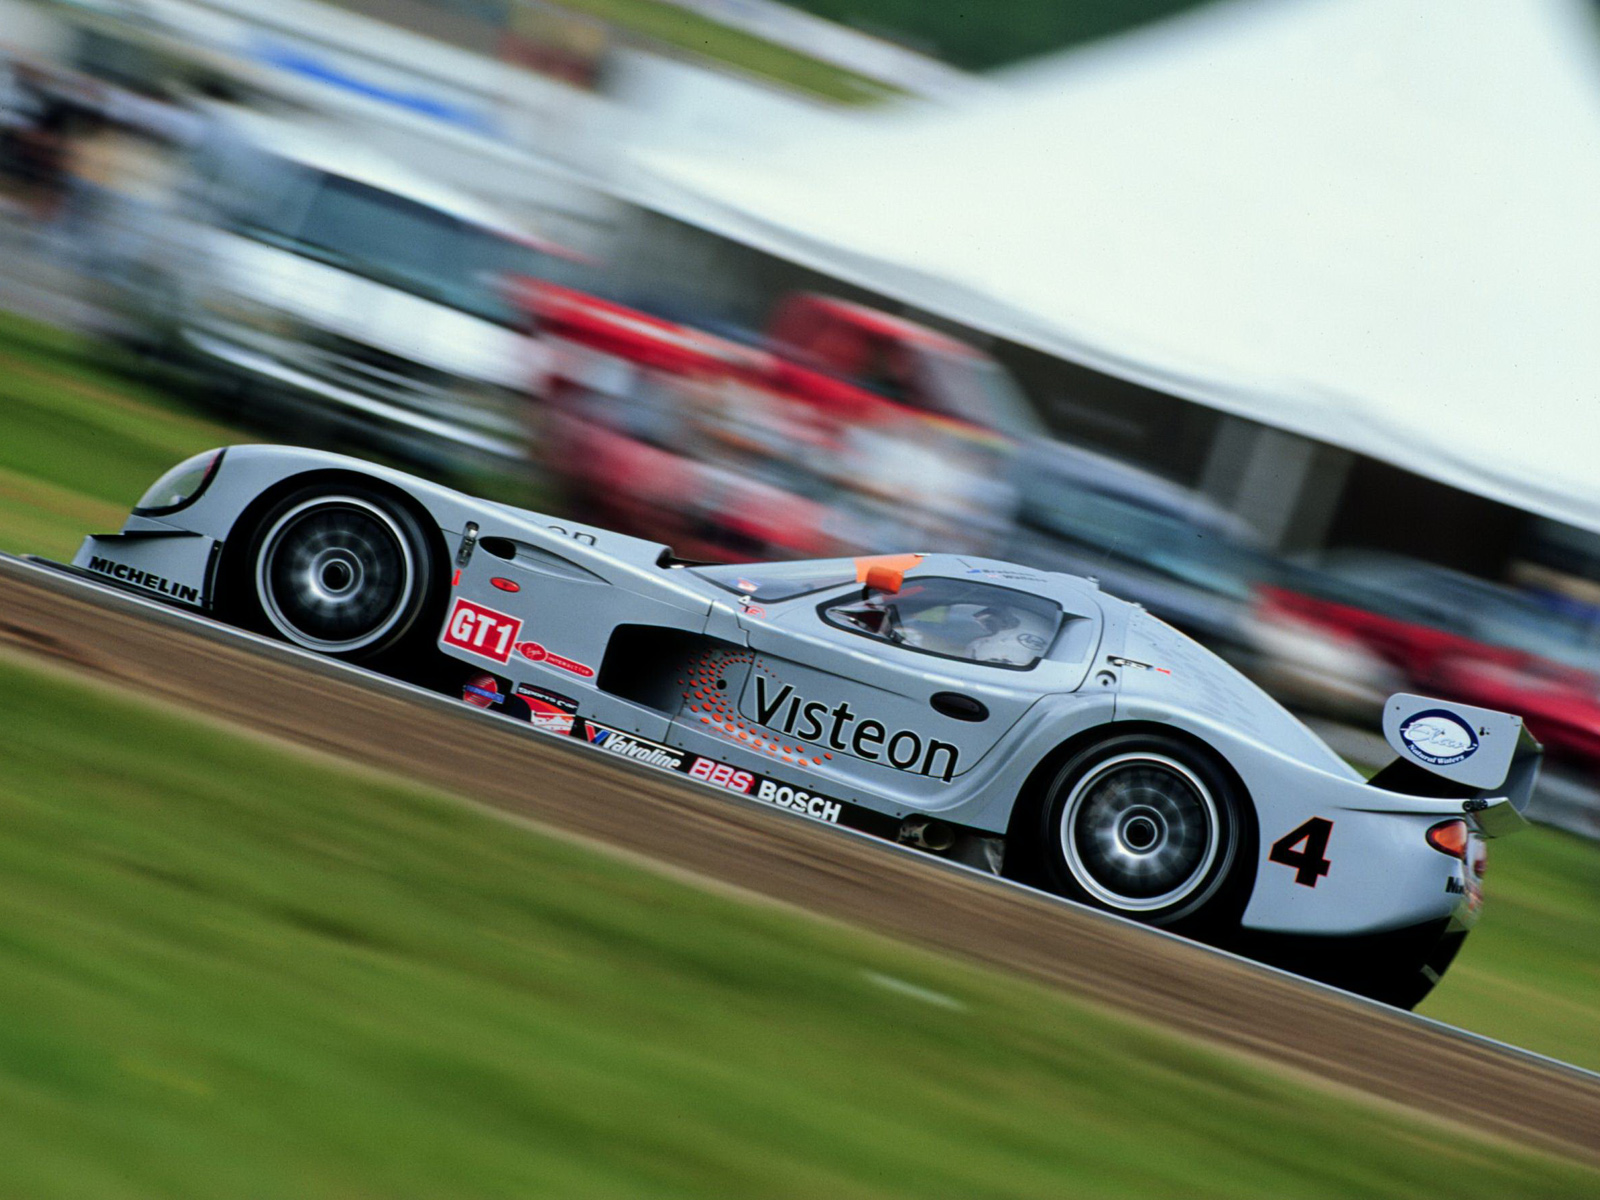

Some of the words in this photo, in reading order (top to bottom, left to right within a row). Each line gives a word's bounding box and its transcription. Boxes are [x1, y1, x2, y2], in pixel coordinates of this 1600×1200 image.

[88, 555, 199, 602] MICHELIN
[450, 607, 514, 655] GT1
[602, 731, 682, 770] Valvoline
[755, 675, 960, 783] Visteon
[688, 757, 755, 794] BBS
[757, 780, 842, 823] BOSCH
[1268, 815, 1334, 889] 4
